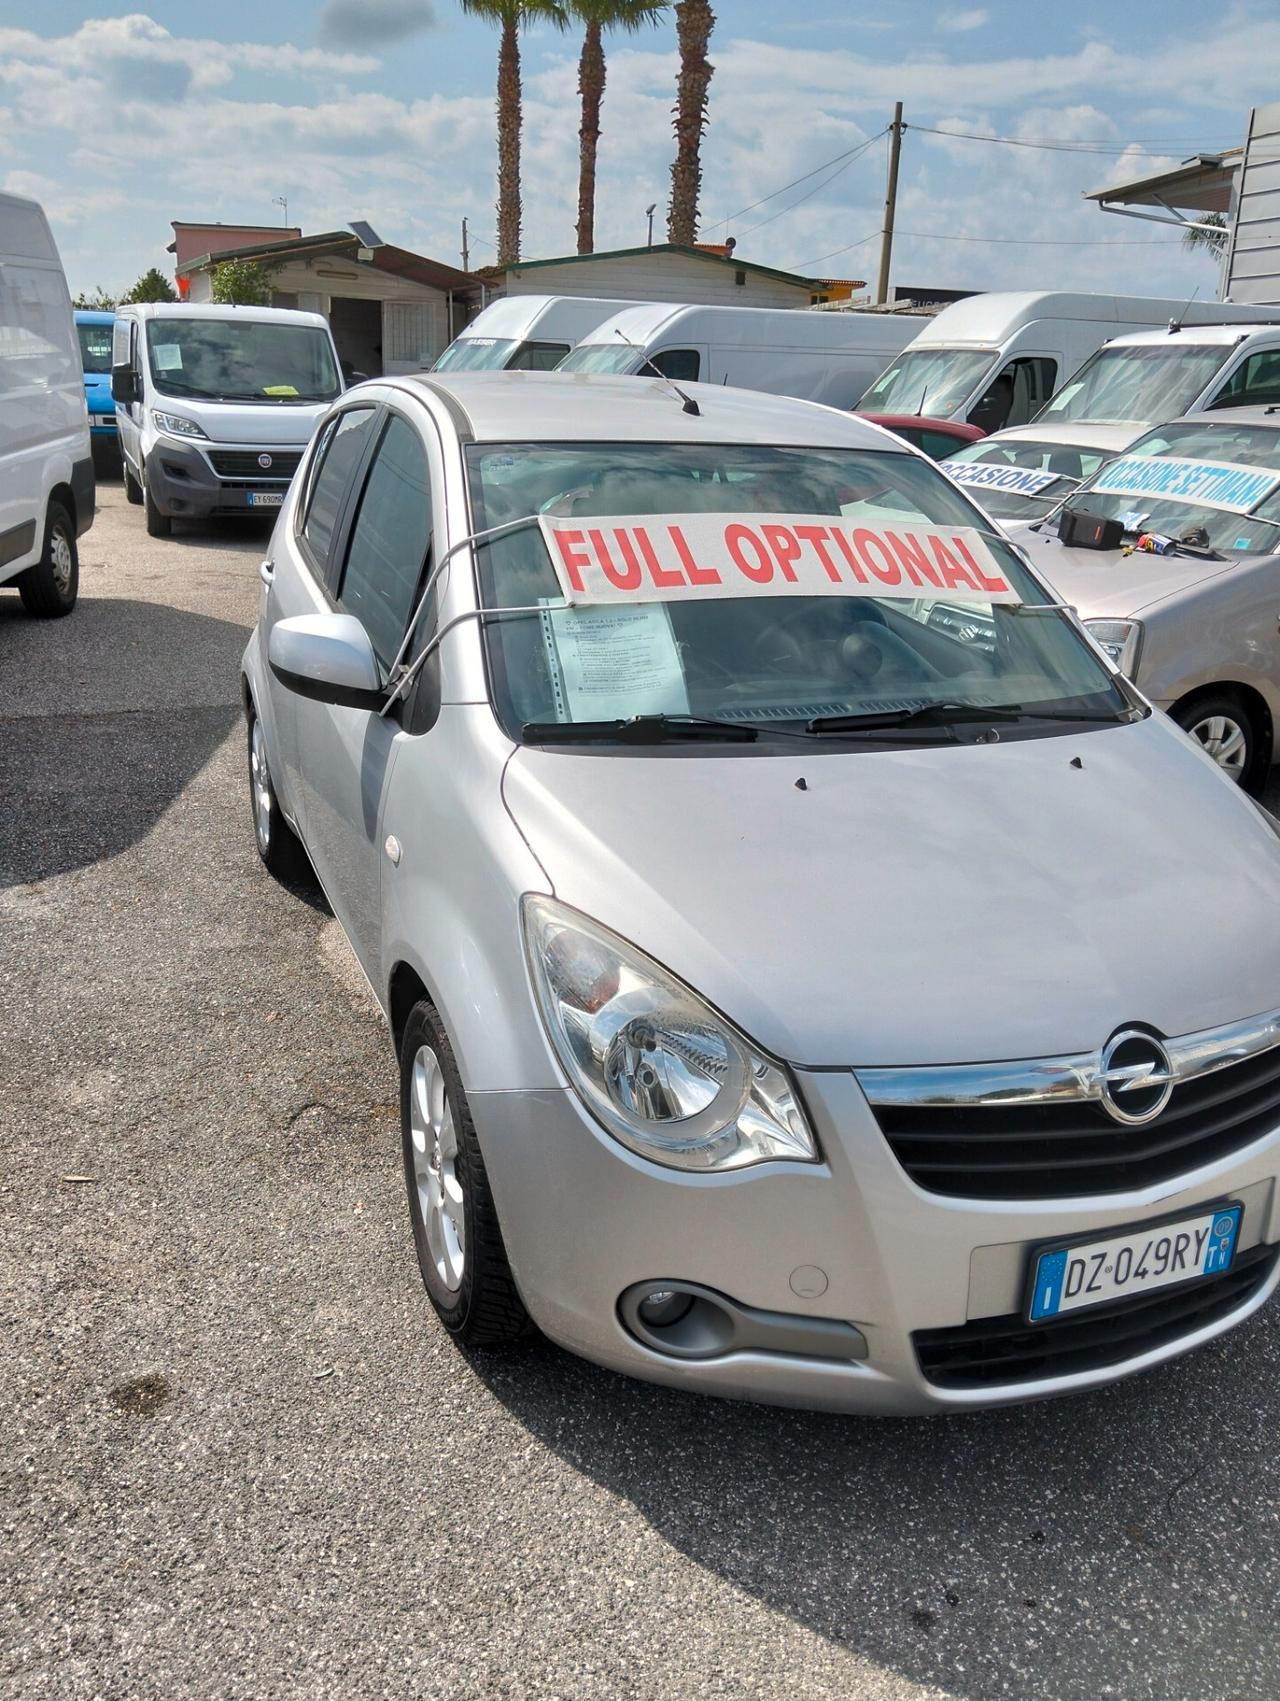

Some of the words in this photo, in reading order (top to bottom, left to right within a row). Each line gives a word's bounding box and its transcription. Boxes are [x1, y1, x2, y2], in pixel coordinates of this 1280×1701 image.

[1099, 460, 1192, 493] OCCASIONE
[552, 526, 722, 592] FULL
[724, 523, 1009, 593] OPTIONAL
